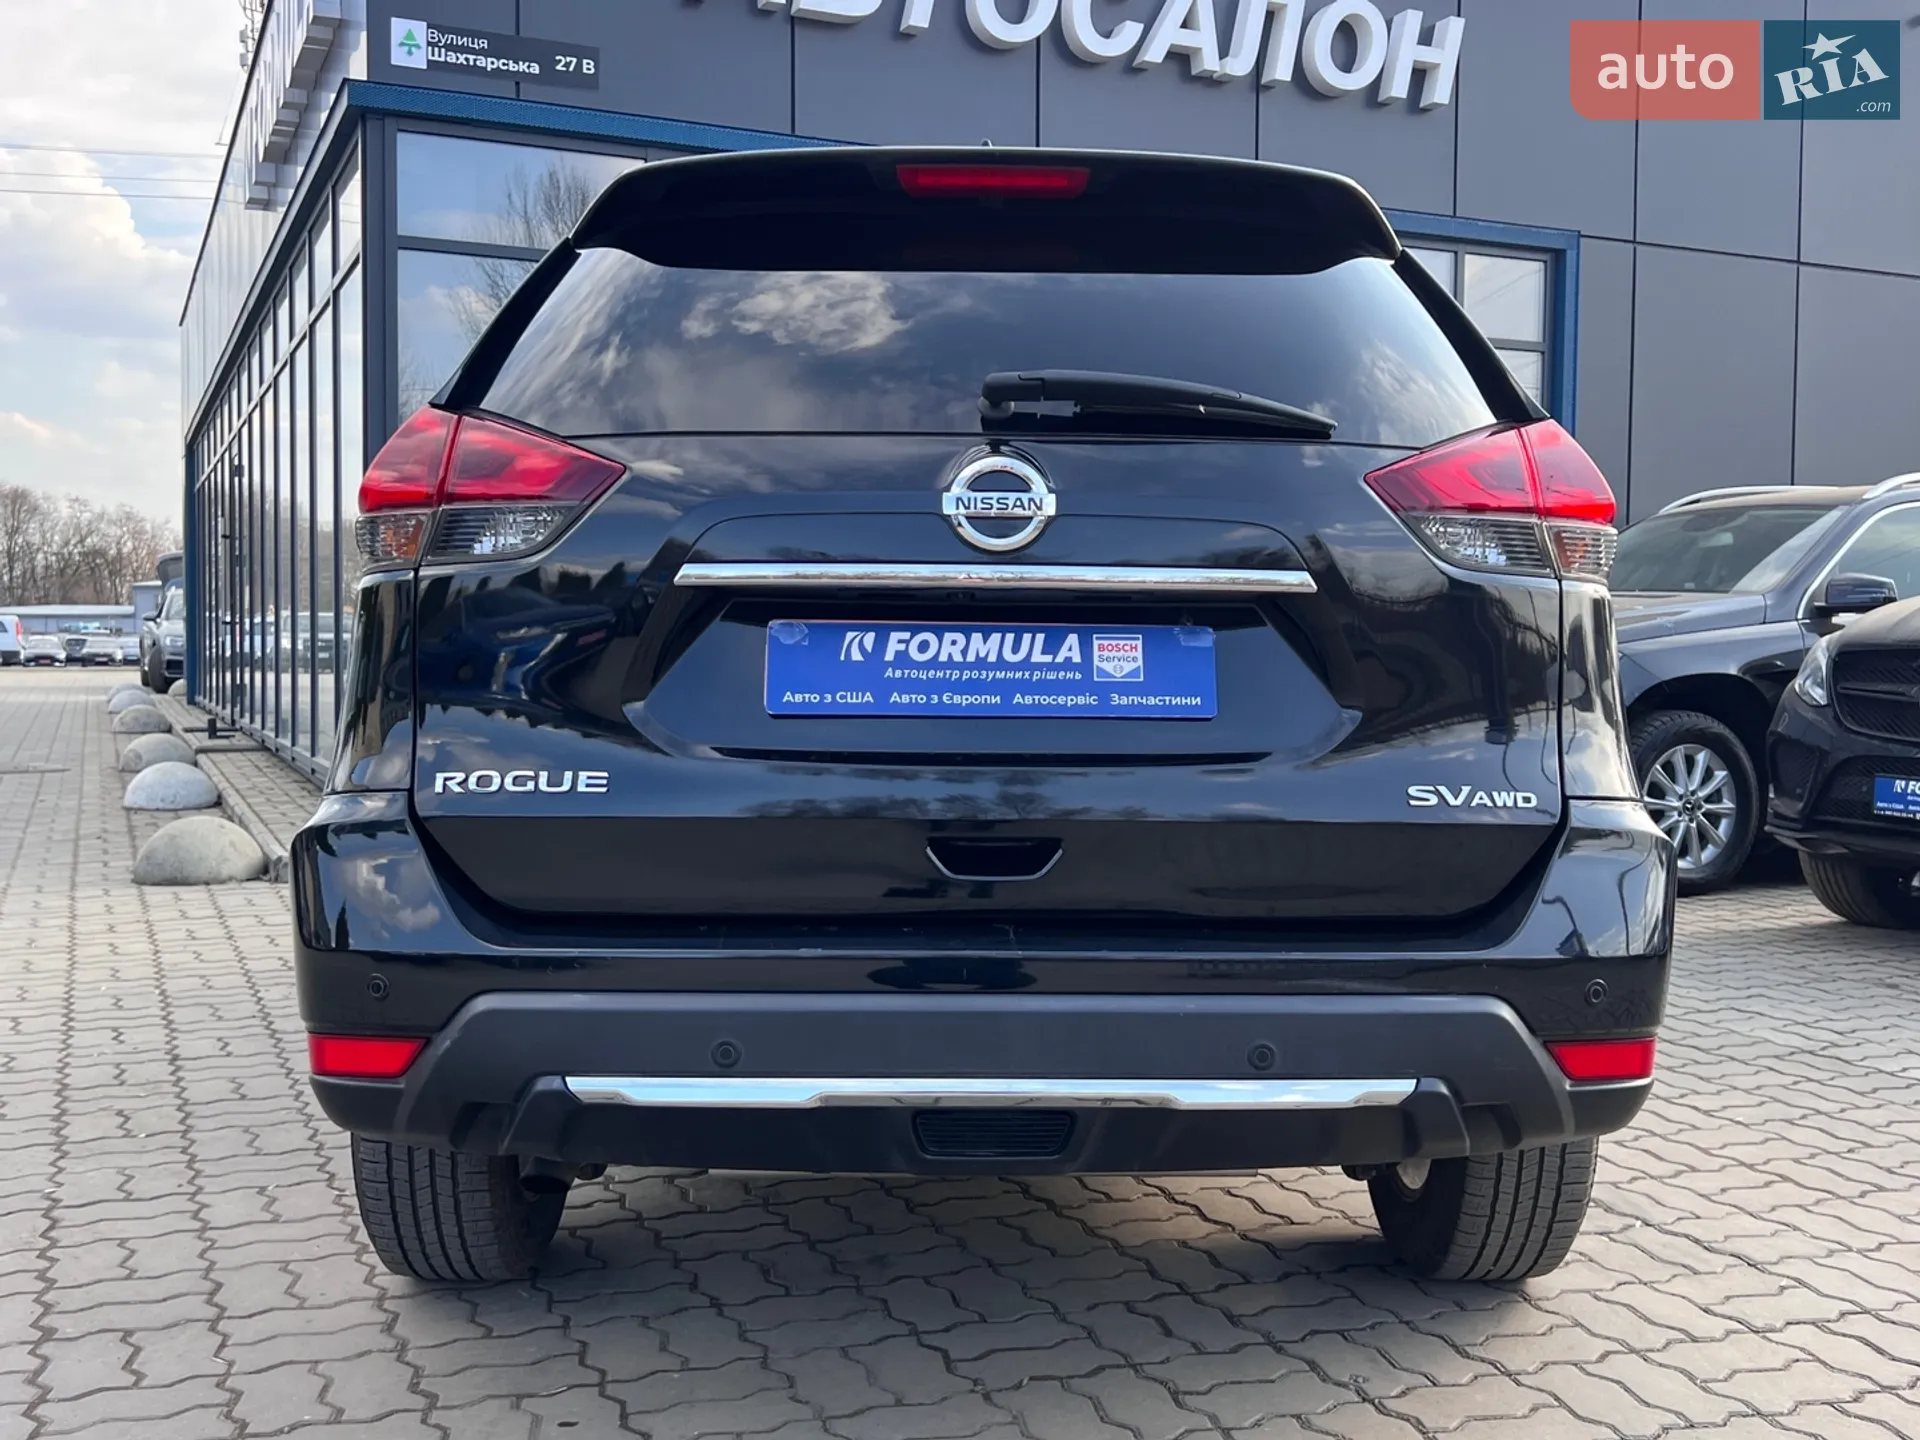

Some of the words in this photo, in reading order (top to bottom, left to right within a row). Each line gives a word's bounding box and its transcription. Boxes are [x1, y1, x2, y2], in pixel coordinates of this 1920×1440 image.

[427, 28, 489, 50] Вулиця
[427, 46, 540, 75] Шахтарська
[554, 55, 578, 72] 27
[757, 0, 1465, 109] ОСАЛОН
[955, 496, 1044, 512] NISSAN
[884, 631, 1082, 663] FORMULA
[1097, 643, 1139, 653] BOSCH
[1097, 654, 1139, 663] Service
[884, 667, 960, 681] Автоцентр
[961, 668, 1031, 682] розумних
[1032, 668, 1083, 682] рішень
[782, 691, 820, 703] Авто
[823, 693, 832, 703] з
[836, 691, 874, 703] США
[889, 692, 927, 704] Авто
[930, 694, 939, 704] з
[942, 692, 1001, 707] Європи
[1012, 691, 1099, 707] Автосервіс
[1110, 693, 1202, 706] Запчастини
[434, 770, 610, 794] ROGUE
